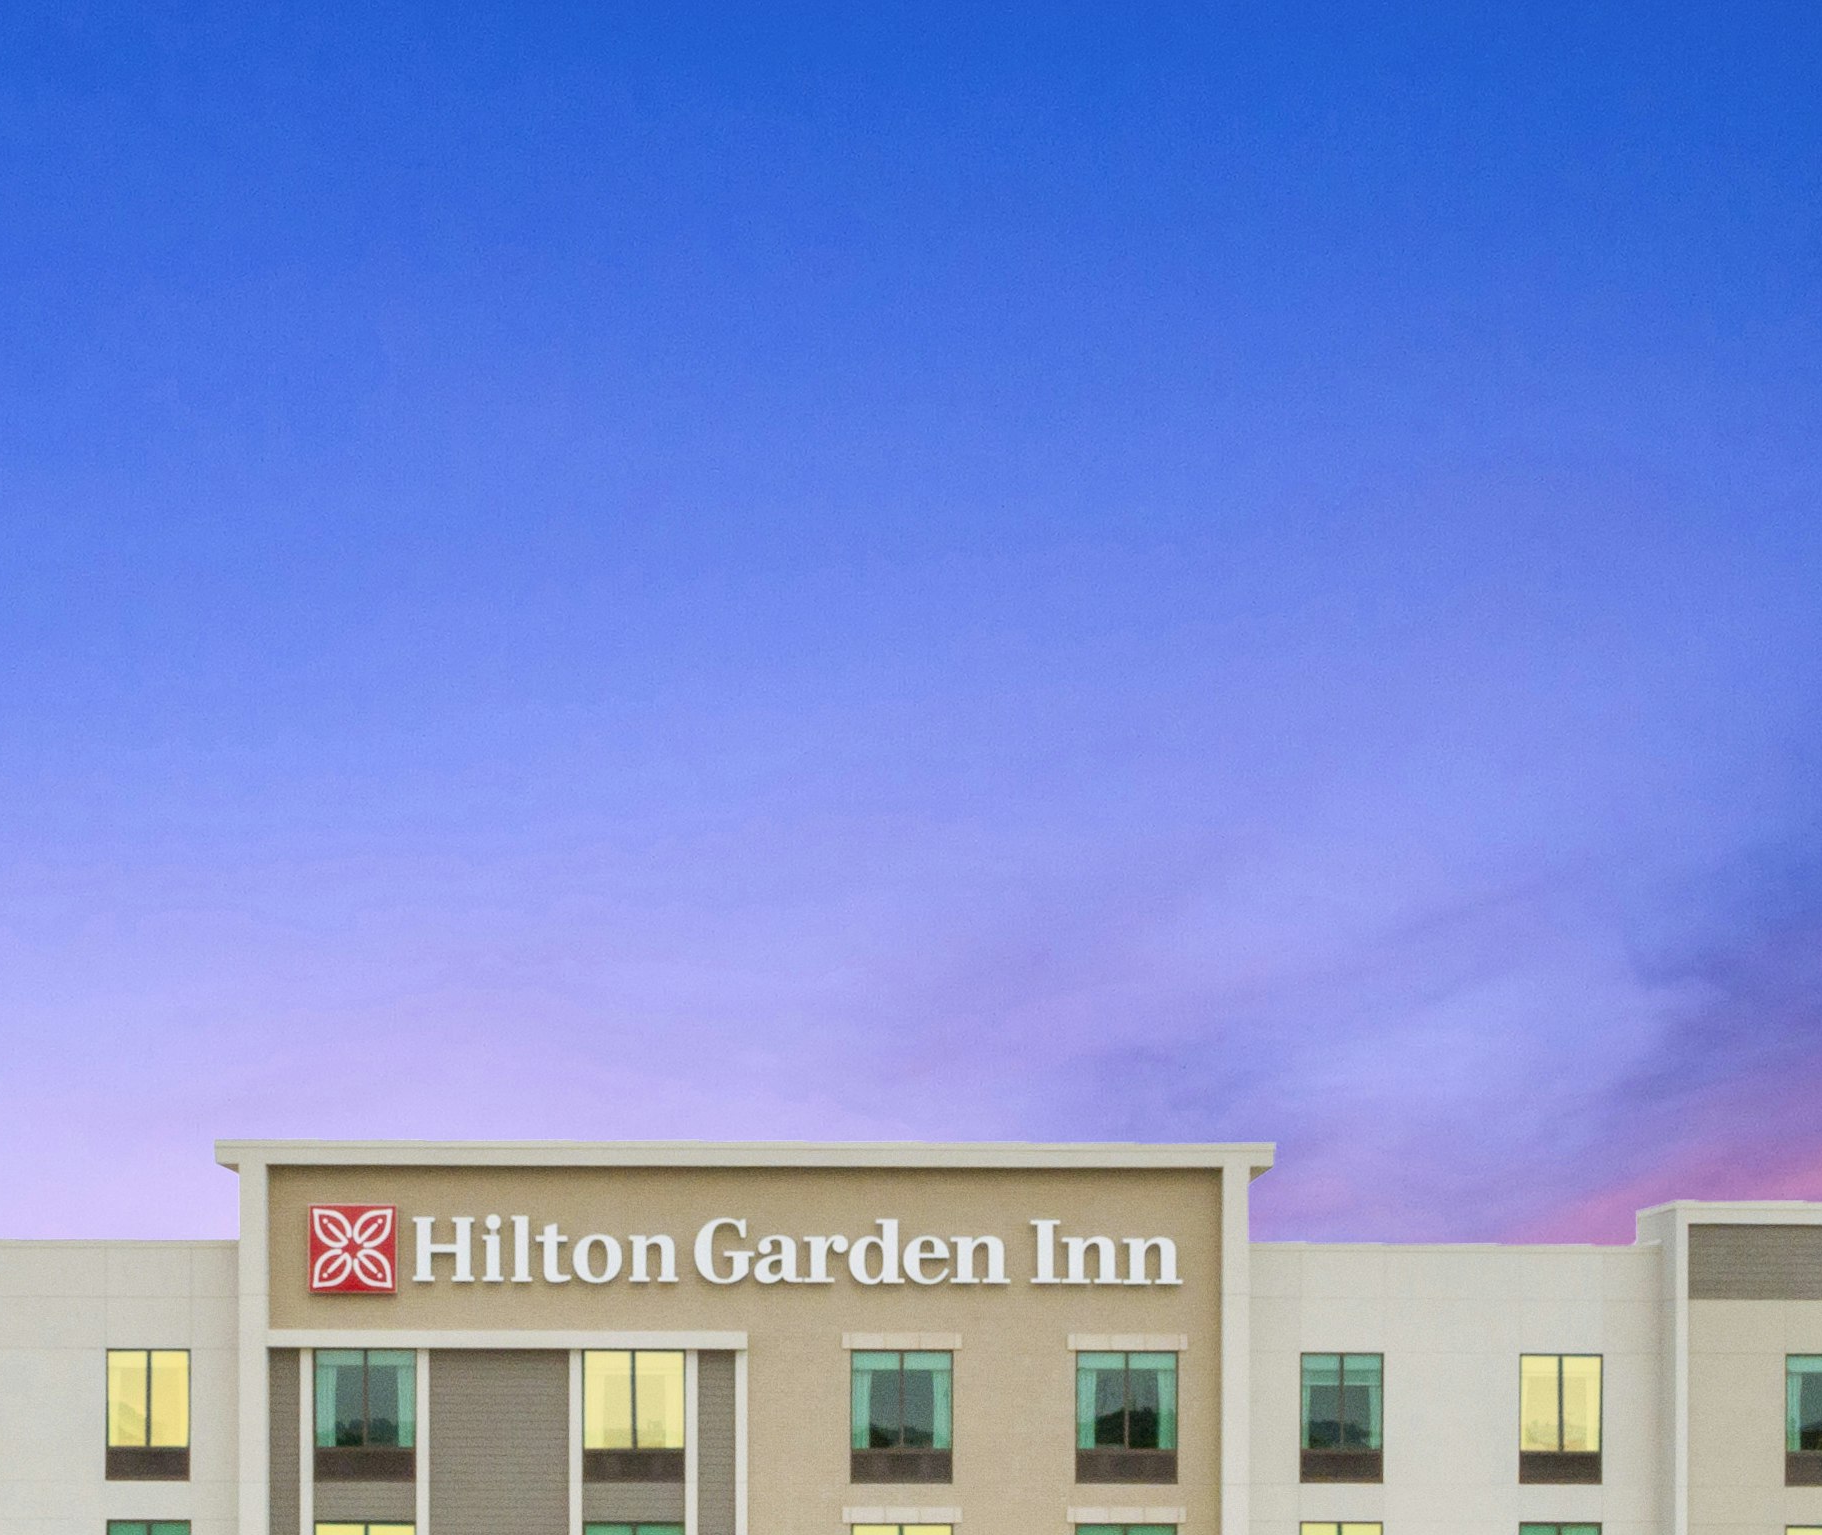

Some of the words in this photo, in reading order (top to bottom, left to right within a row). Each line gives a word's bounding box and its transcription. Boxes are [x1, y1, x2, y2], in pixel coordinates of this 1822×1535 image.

[411, 1214, 679, 1284] Hilton
[693, 1216, 1010, 1286] Garden
[1029, 1218, 1184, 1286] Inn
